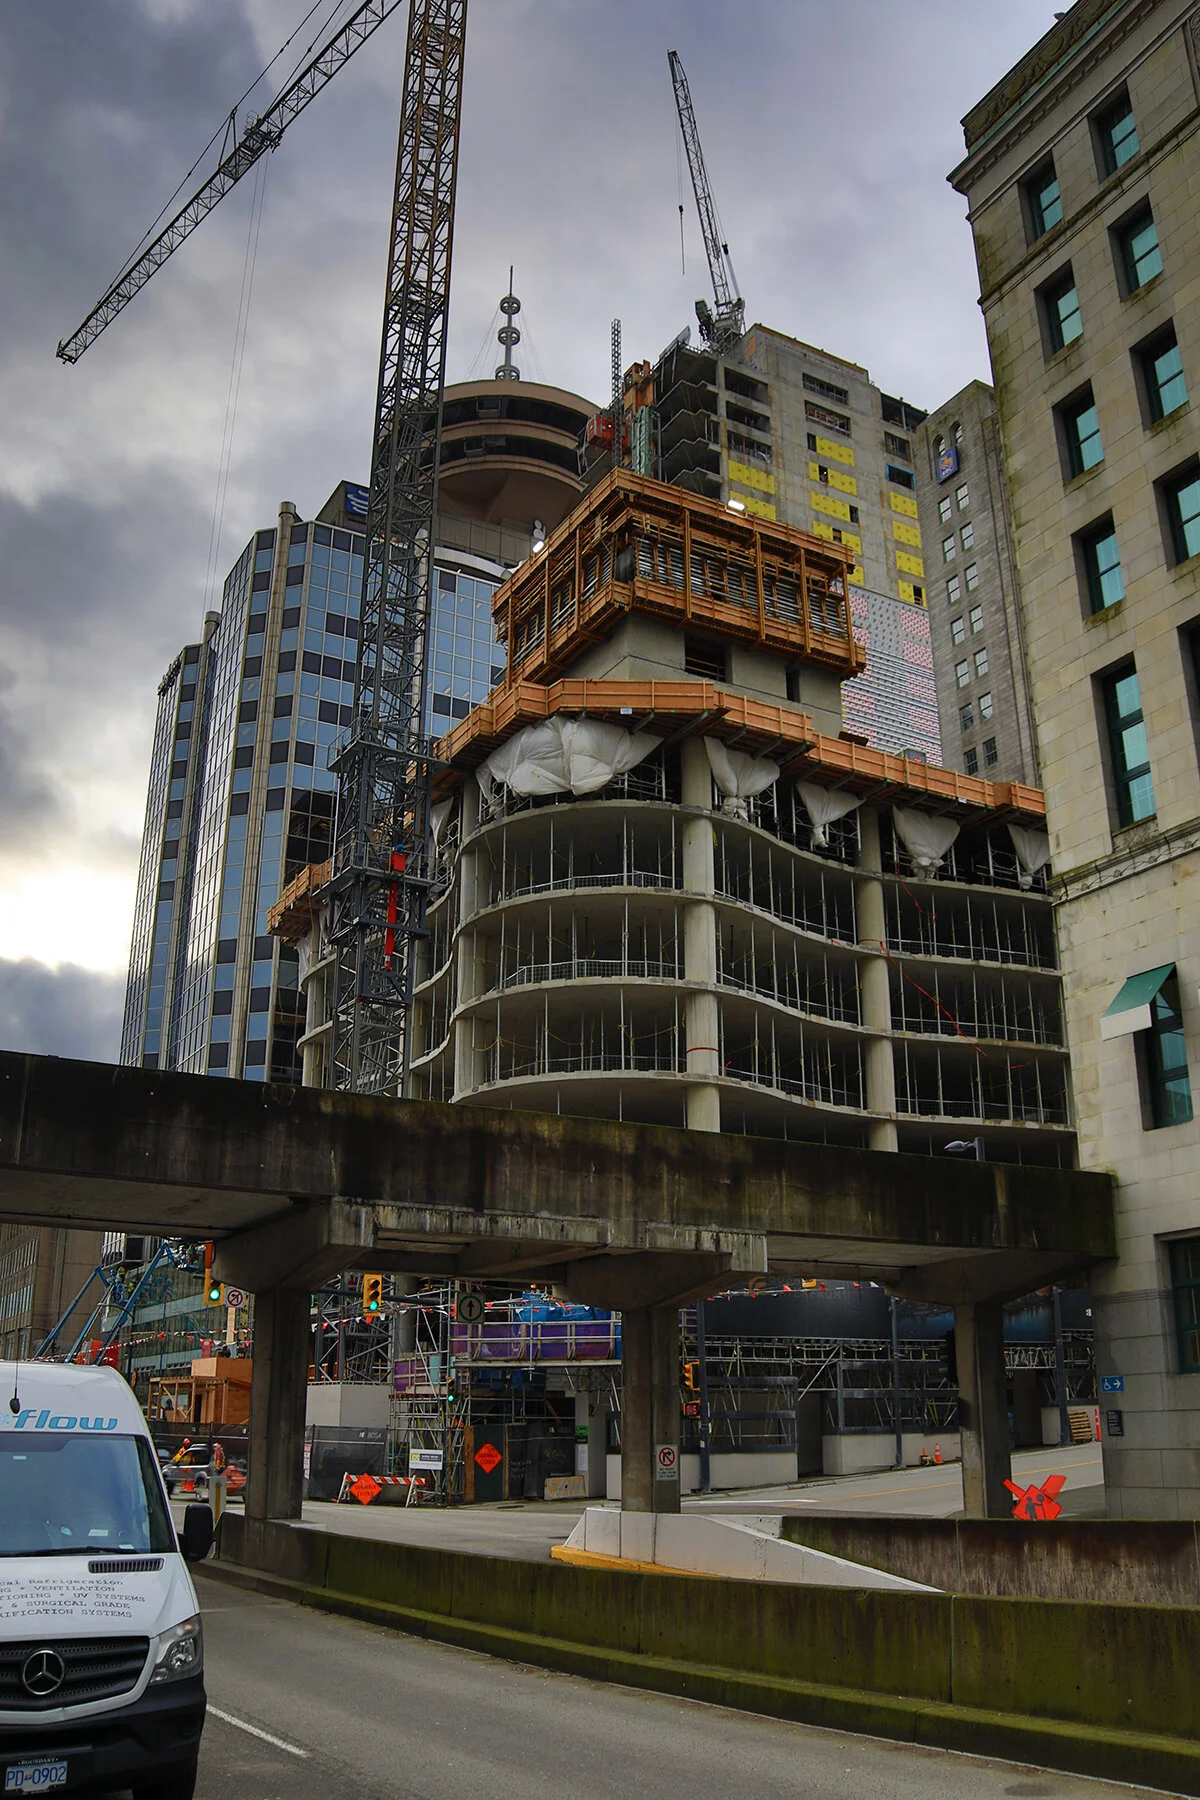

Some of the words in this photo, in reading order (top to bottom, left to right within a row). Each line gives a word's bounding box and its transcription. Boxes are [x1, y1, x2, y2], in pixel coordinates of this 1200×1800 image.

[12, 1409, 118, 1430] flow
[96, 1593, 145, 1603] SYSTEMS
[94, 1601, 131, 1609] GRADE
[81, 1609, 133, 1618] SYSTEMS
